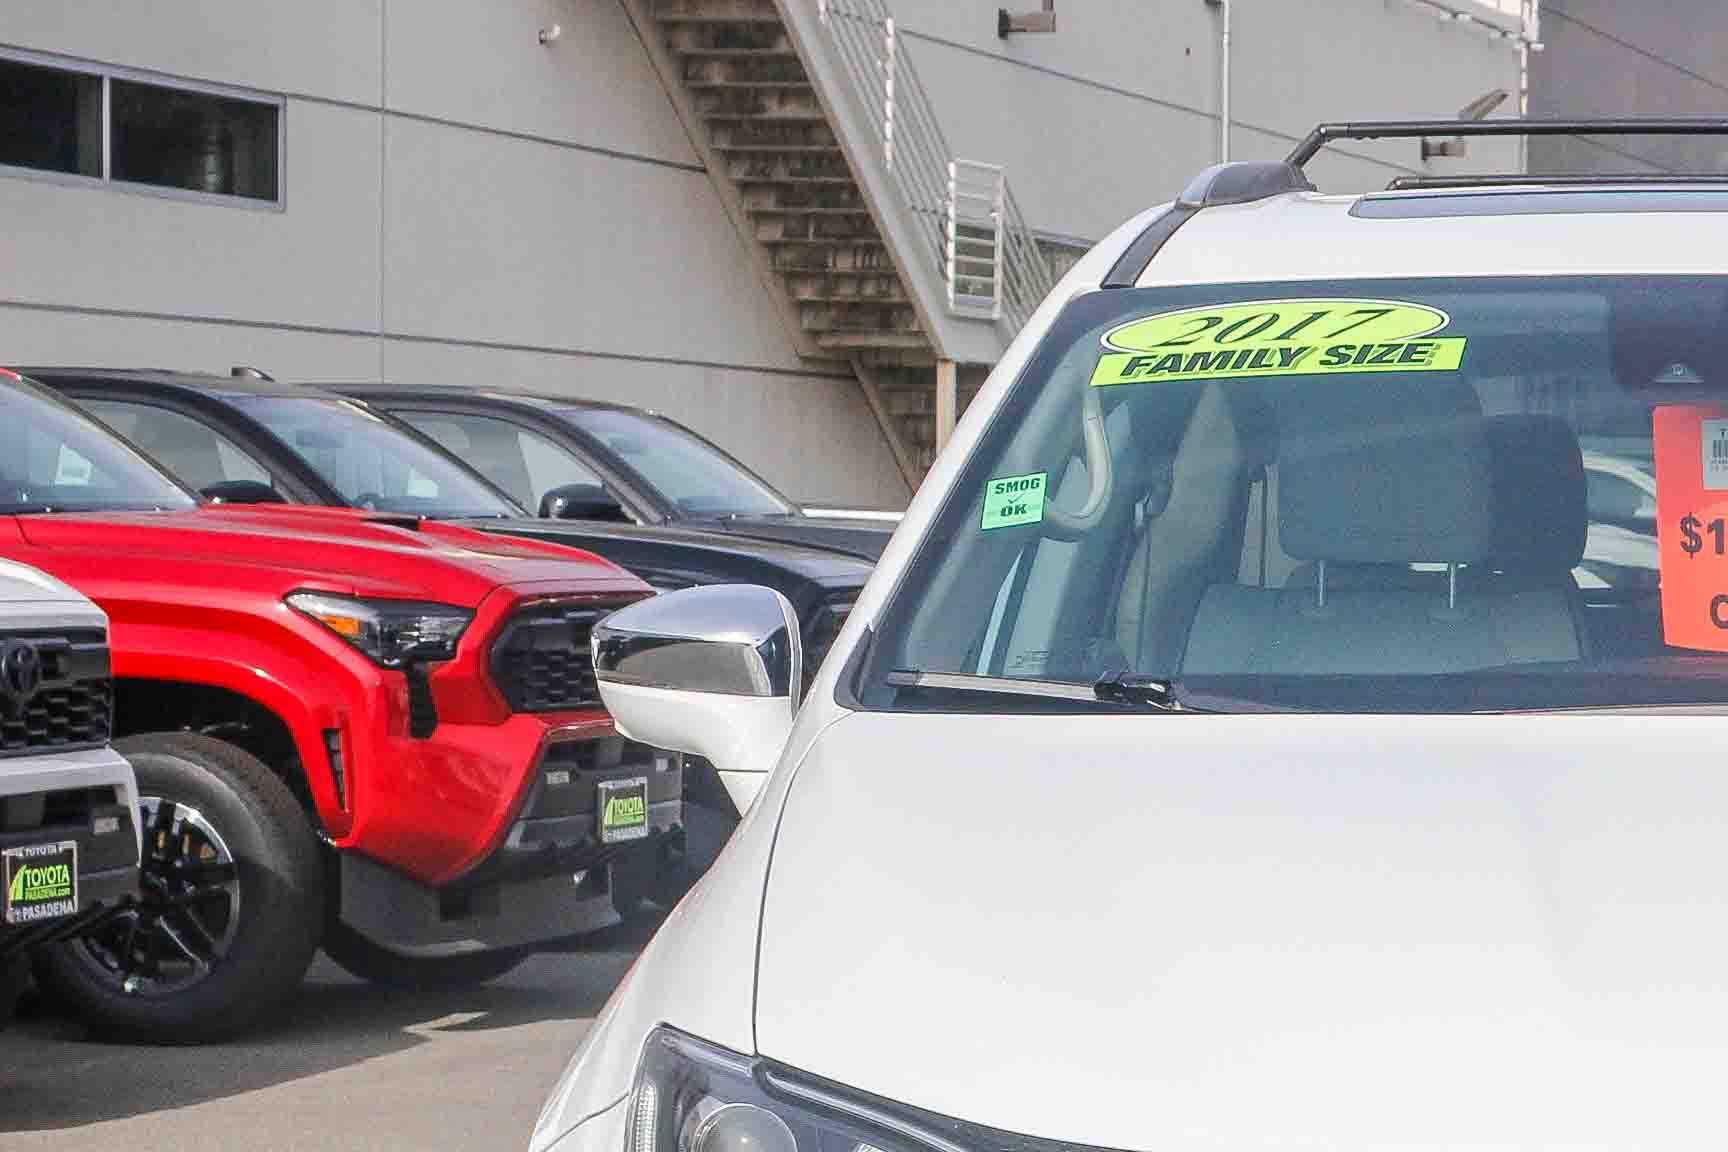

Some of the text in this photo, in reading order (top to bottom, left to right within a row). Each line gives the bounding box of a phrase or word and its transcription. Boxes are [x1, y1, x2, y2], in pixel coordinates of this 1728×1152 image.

[1153, 308, 1396, 348] 2017
[1119, 341, 1442, 379] FAMILY SIZE
[994, 478, 1041, 494] SMOG
[1000, 503, 1028, 517] OK
[25, 864, 70, 887] TOYOTA
[22, 899, 74, 920] PASADENA
